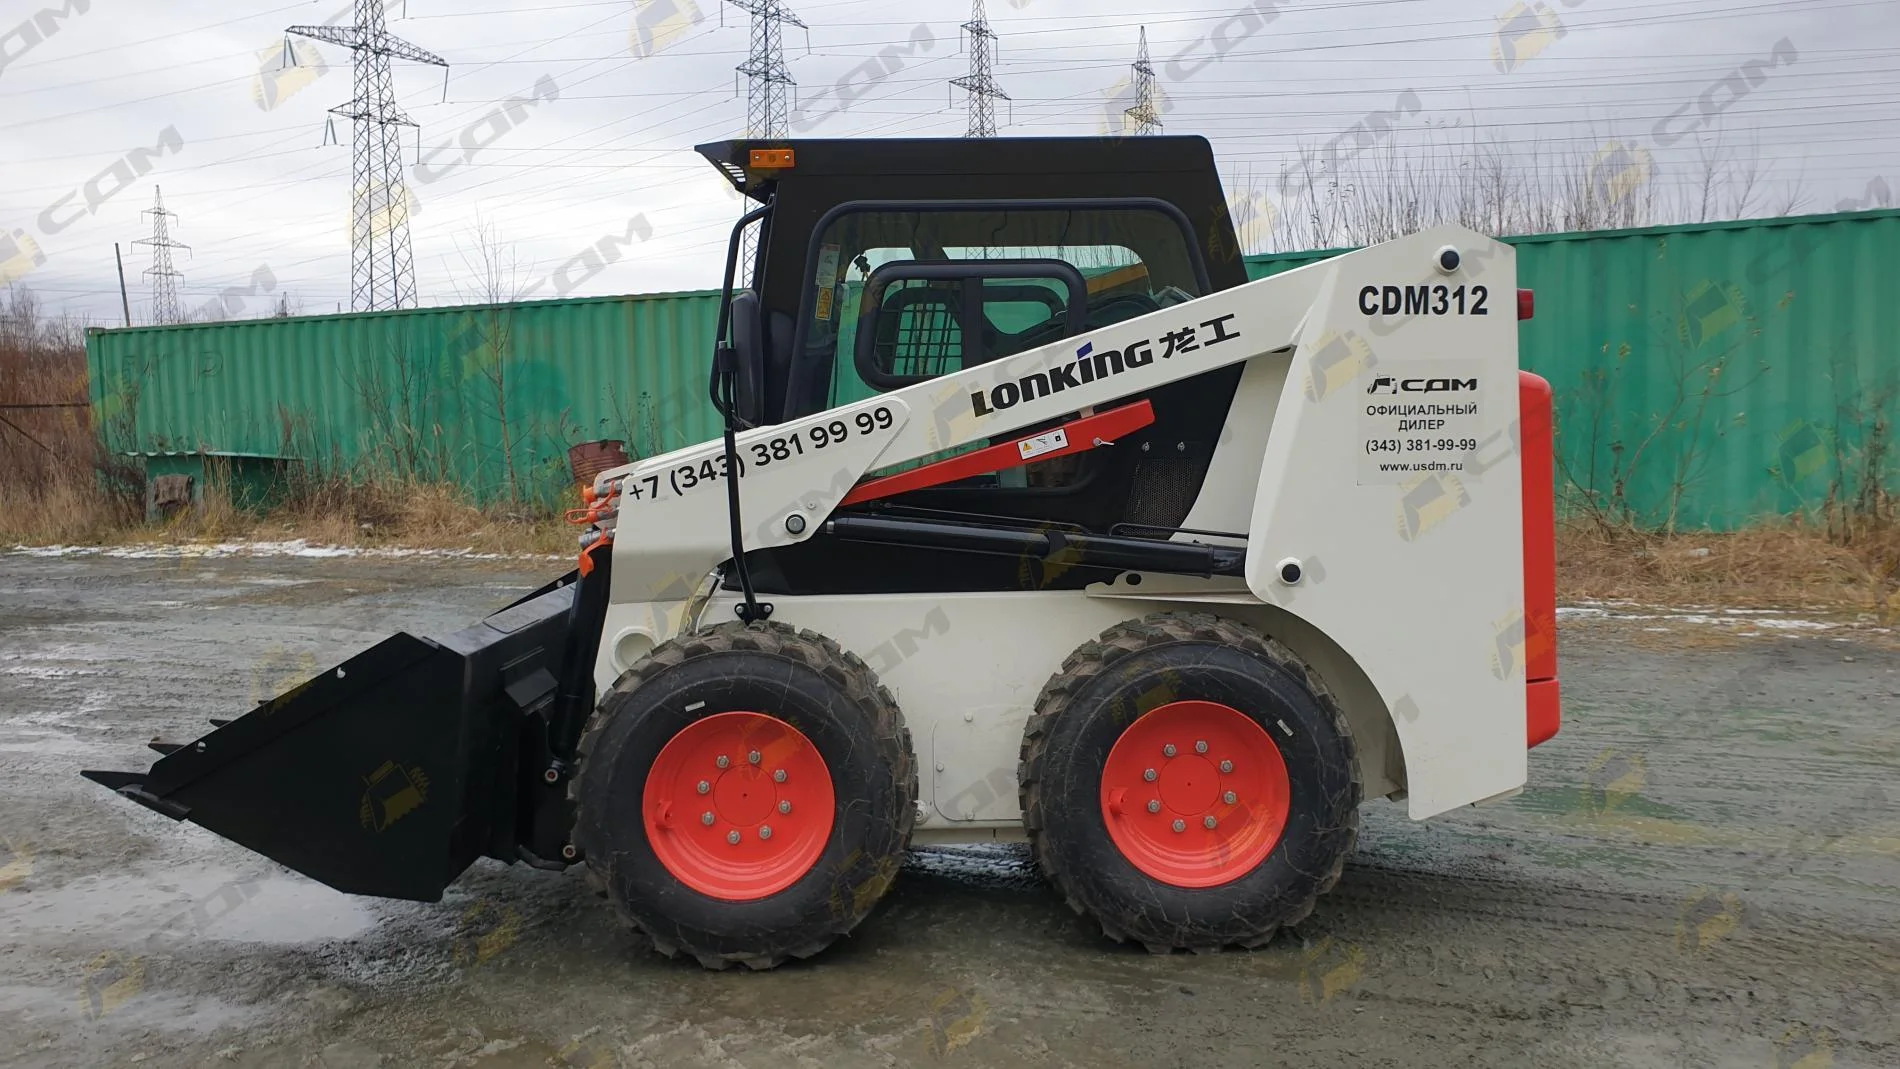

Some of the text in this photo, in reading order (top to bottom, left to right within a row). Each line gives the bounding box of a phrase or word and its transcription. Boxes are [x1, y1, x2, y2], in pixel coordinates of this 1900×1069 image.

[1358, 285, 1488, 315] CDM312
[1366, 401, 1478, 417] ОФИЦИАЛЬНЫЙ
[1398, 419, 1445, 432] ДИЛЕР
[629, 475, 659, 500] +7
[751, 433, 804, 467] 381
[809, 420, 848, 449] 99
[854, 406, 893, 435] 99
[1366, 439, 1477, 454] (343) 381-99-99
[1379, 461, 1463, 471] www.usdm.ru
